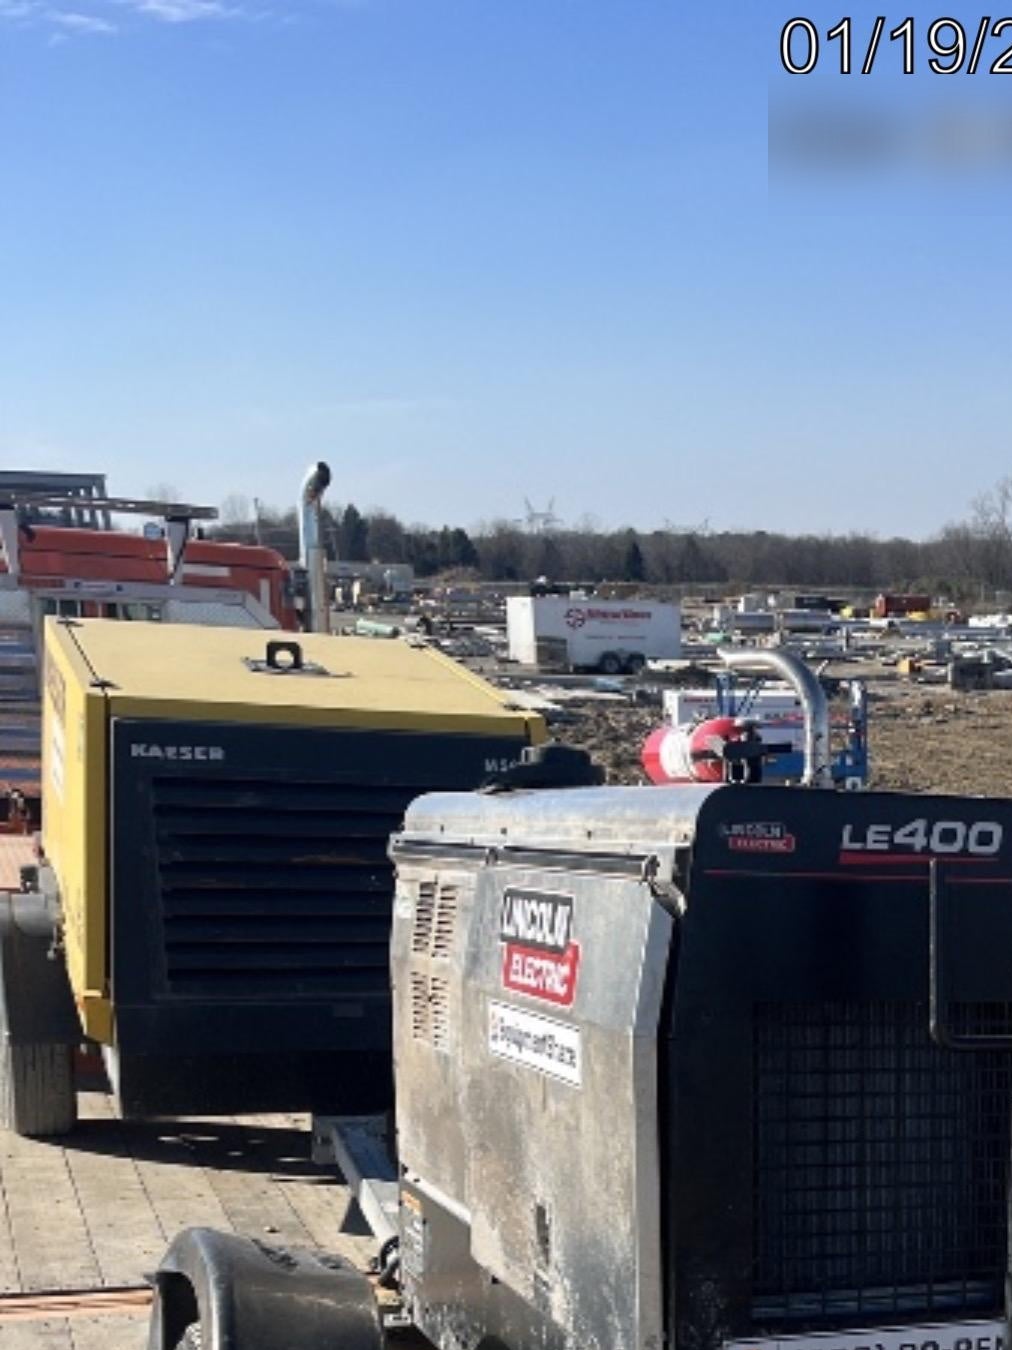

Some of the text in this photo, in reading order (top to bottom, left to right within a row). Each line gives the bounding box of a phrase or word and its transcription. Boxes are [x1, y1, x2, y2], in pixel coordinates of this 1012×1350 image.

[130, 743, 226, 761] KAESER
[721, 823, 783, 838] LINCOLN
[842, 818, 1003, 854] LE400
[736, 839, 788, 850] ELECTRIC
[503, 896, 571, 948] LINCOLN
[509, 952, 571, 997] ELECTRIC
